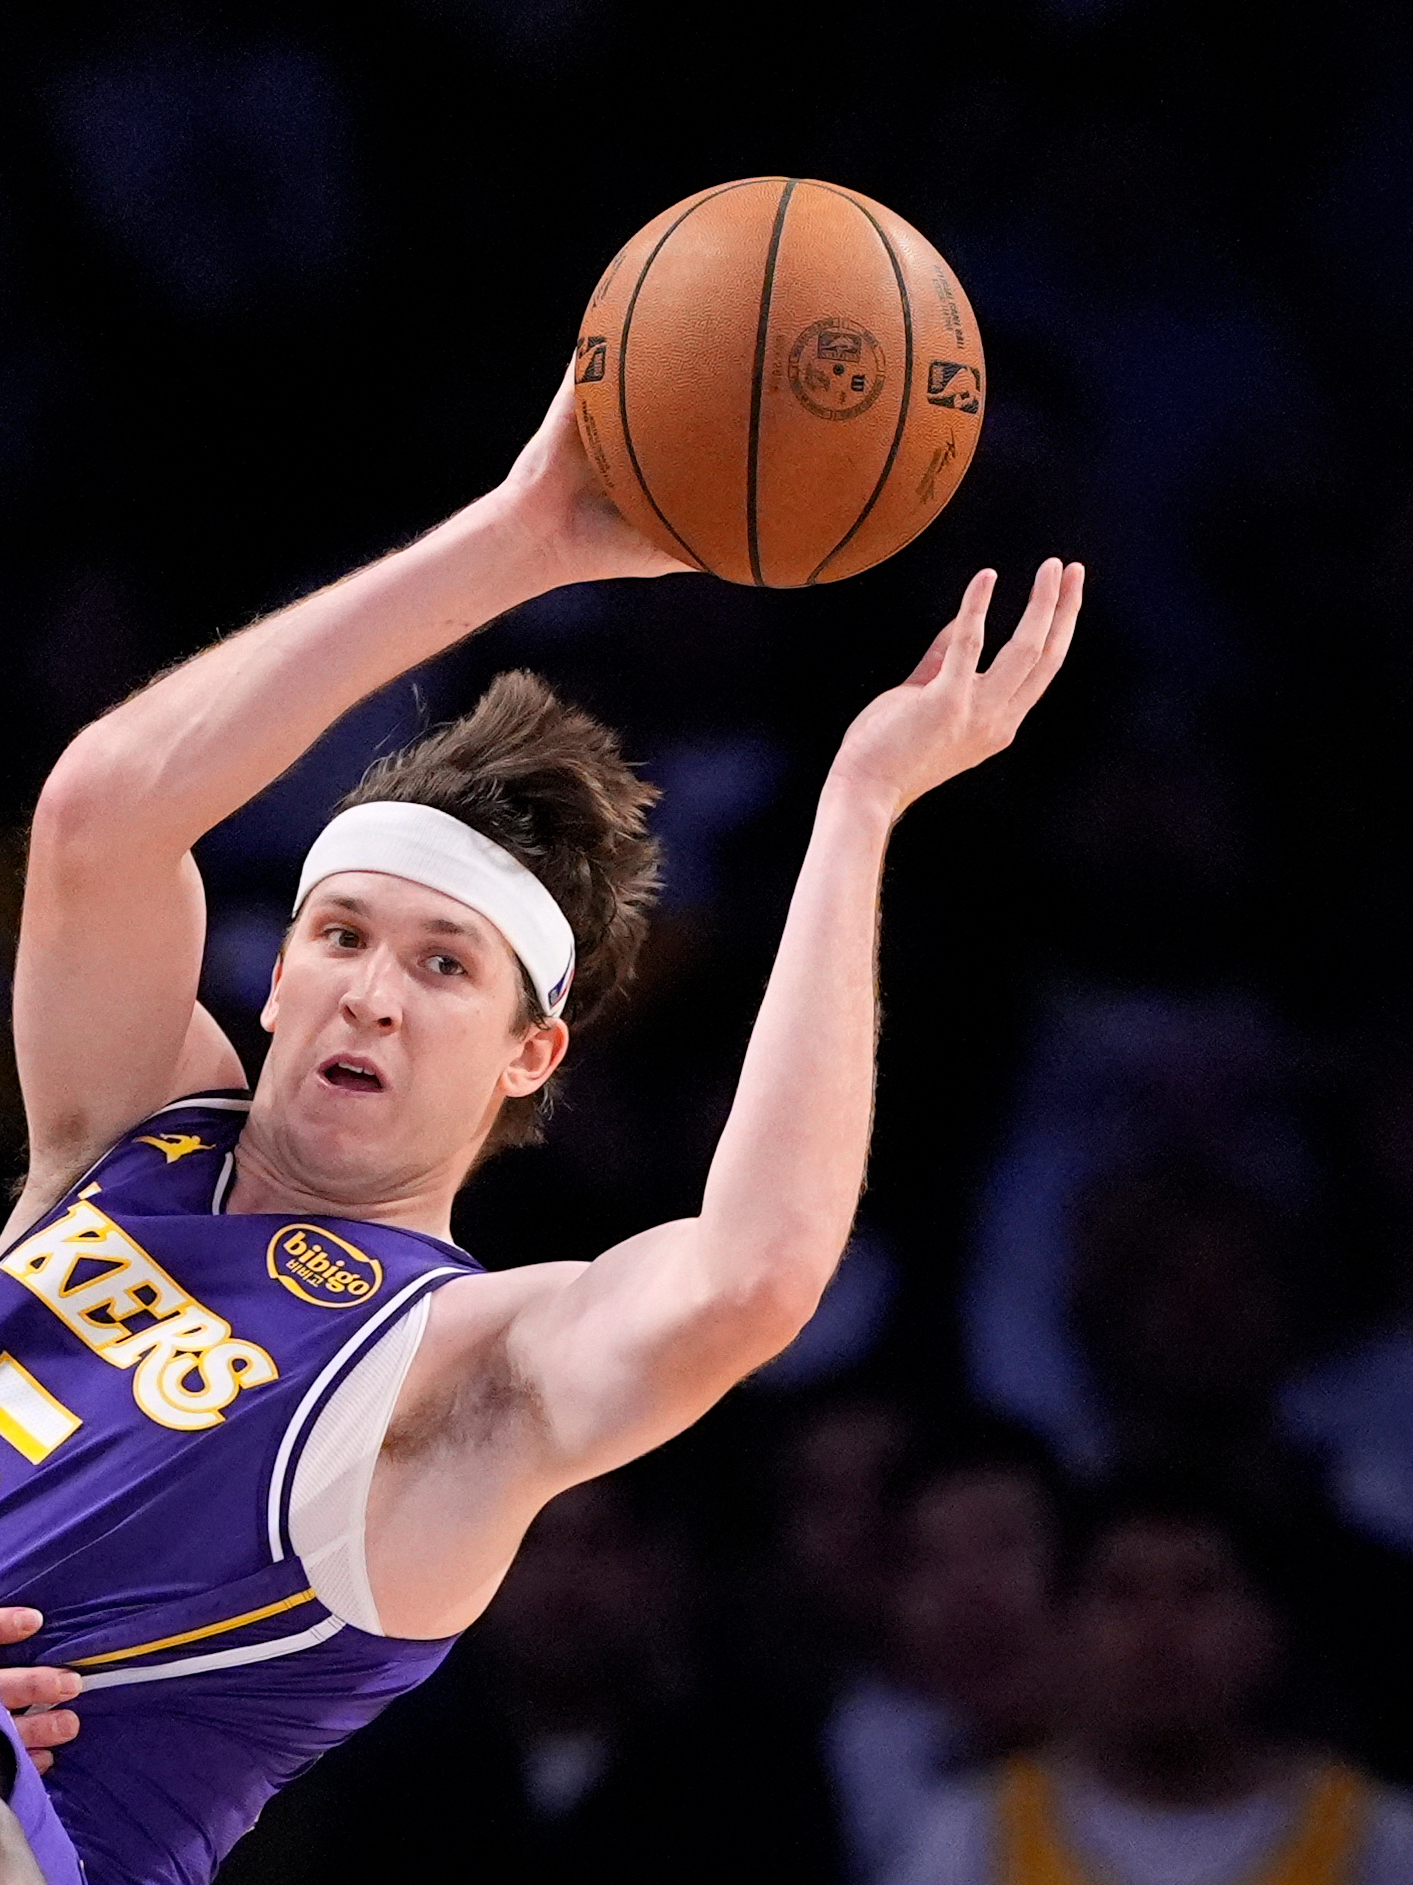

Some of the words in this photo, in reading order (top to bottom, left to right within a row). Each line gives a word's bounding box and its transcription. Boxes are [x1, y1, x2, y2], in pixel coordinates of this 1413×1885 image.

[283, 1230, 371, 1296] bibigo
[285, 1258, 325, 1288] 비비고
[0, 1182, 280, 1432] KERS
